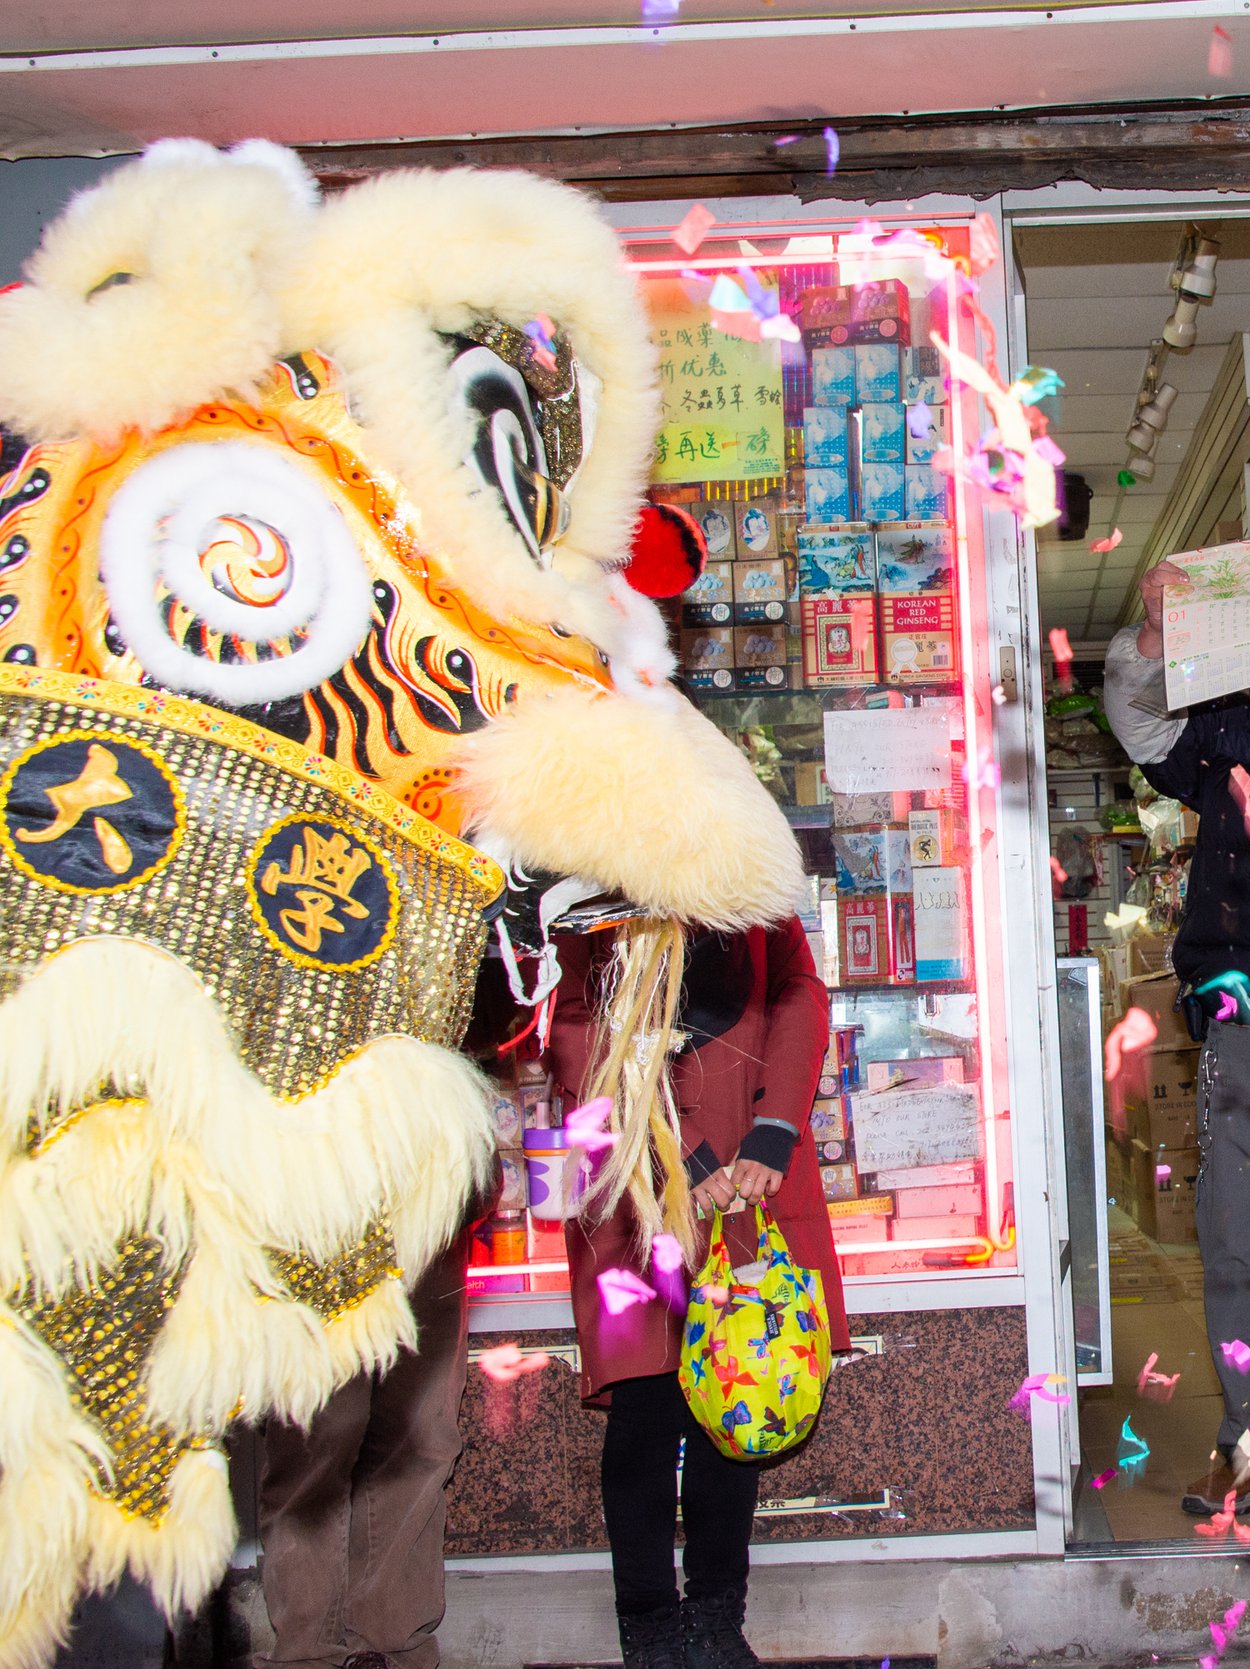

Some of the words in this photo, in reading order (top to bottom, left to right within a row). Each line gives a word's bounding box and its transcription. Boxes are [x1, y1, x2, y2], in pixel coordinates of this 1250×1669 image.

[897, 599, 937, 609] KOREAN
[909, 608, 926, 616] RED
[896, 616, 939, 626] GINSENG
[467, 1280, 485, 1290] alth
